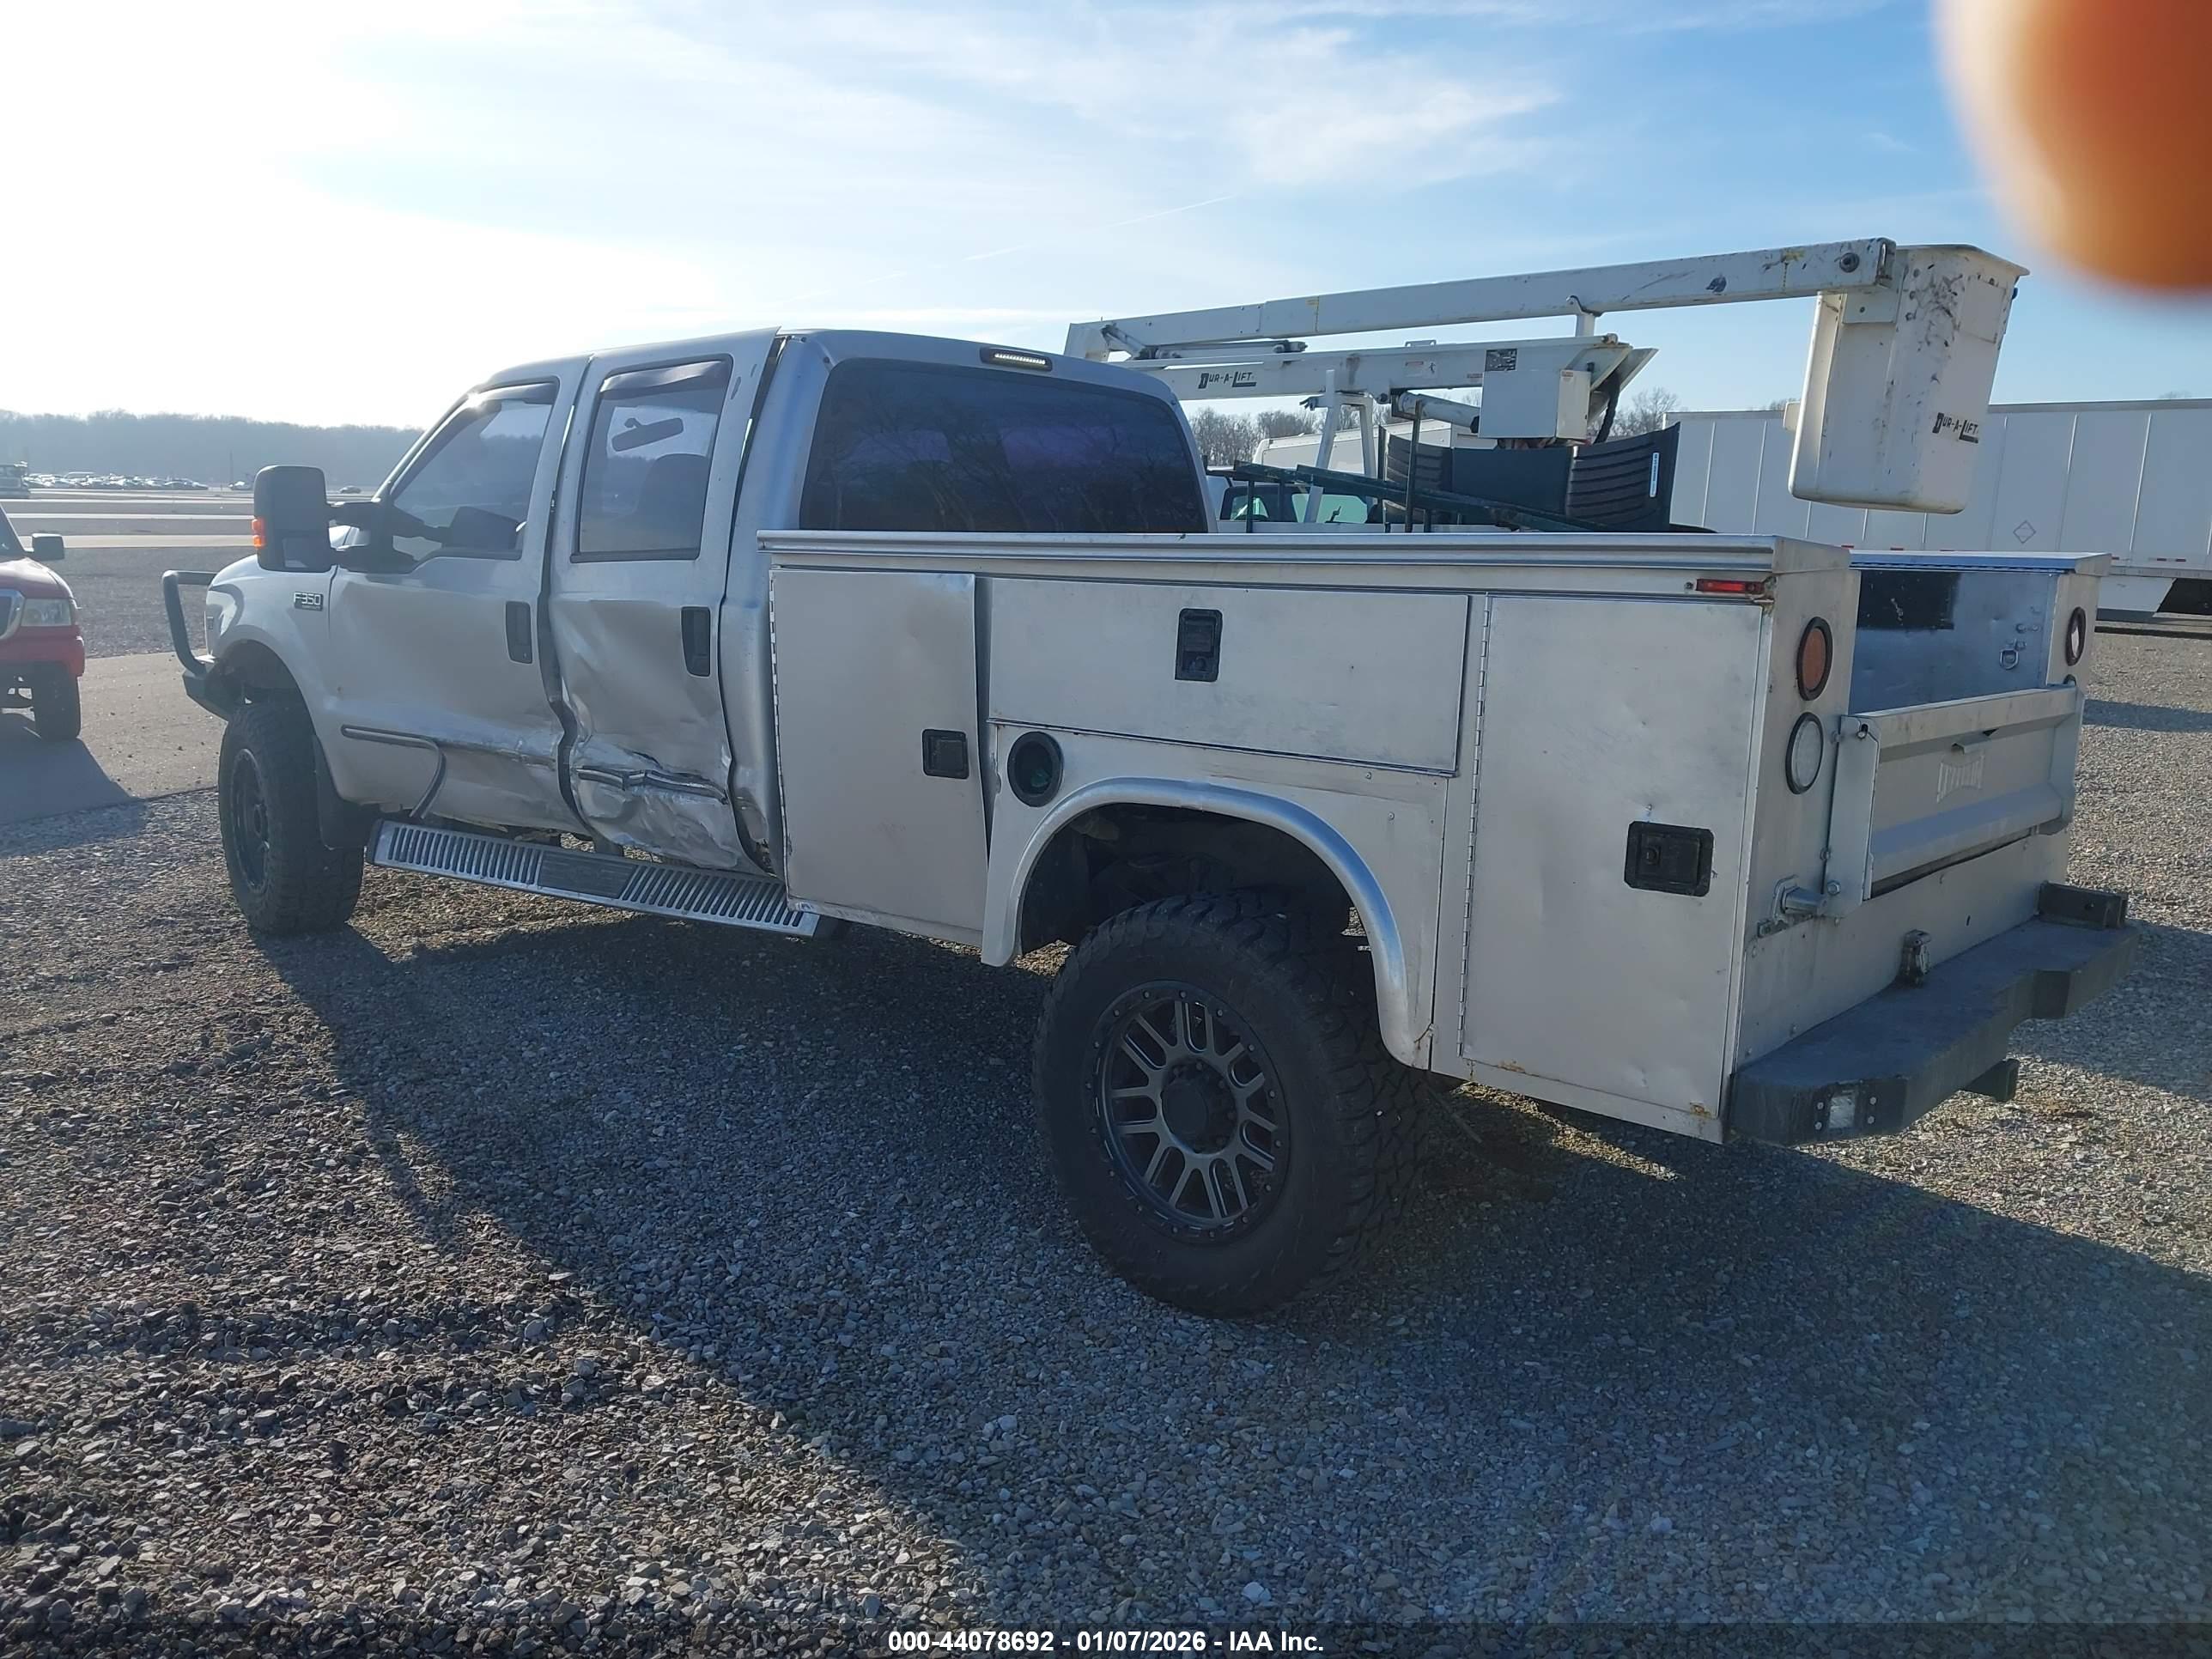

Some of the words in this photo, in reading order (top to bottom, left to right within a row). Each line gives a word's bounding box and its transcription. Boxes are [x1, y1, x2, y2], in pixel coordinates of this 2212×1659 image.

[1198, 371, 1257, 389] DUR-A-LIFT
[1932, 412, 1979, 444] DUR-A-LIFT
[294, 592, 321, 605] F350
